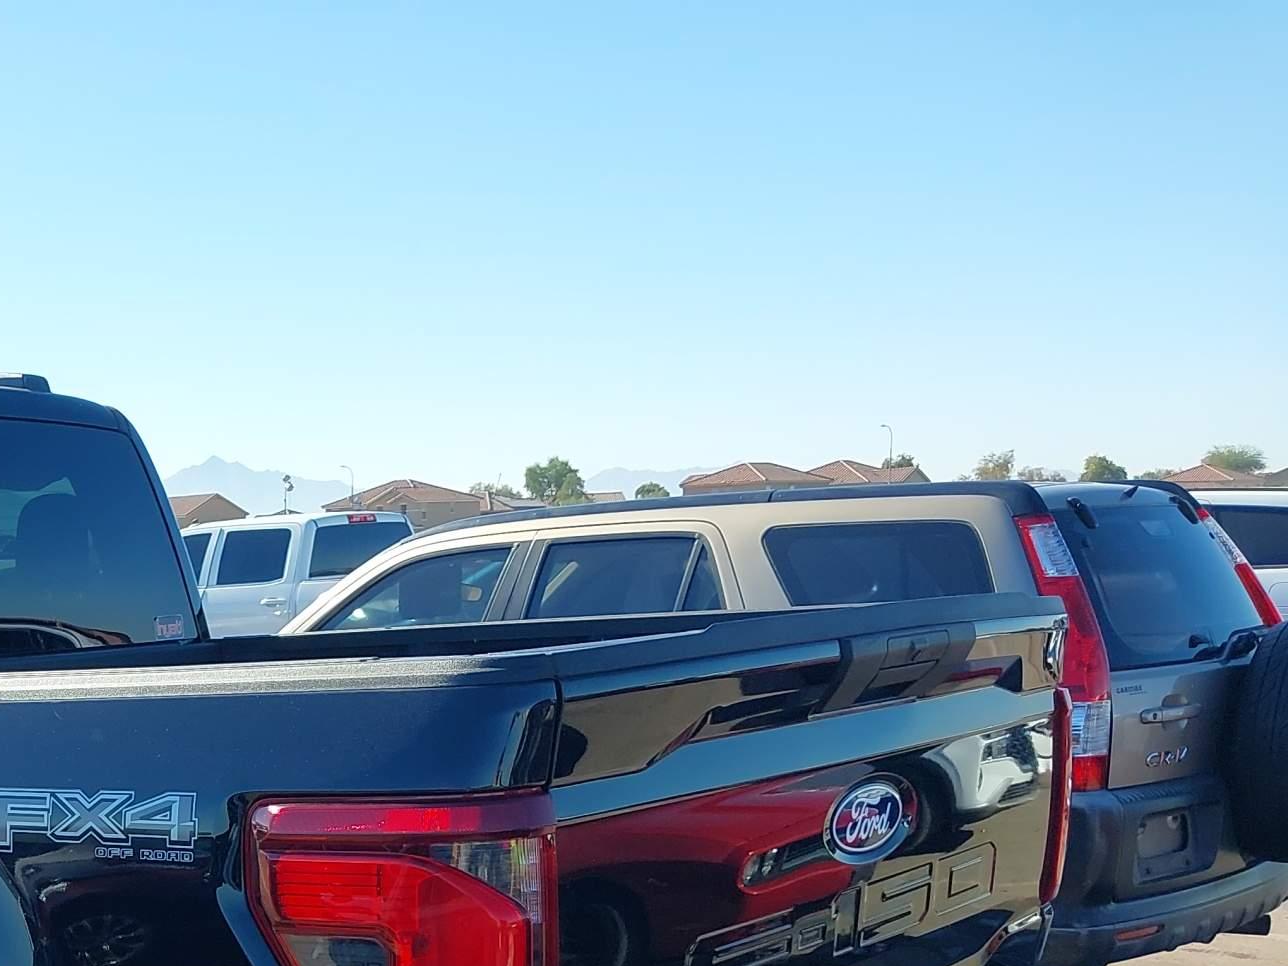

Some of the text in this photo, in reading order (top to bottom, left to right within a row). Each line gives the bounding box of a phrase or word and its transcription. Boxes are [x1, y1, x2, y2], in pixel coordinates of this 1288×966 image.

[1145, 745, 1189, 768] CR-V
[844, 794, 894, 846] Ford
[94, 846, 195, 864] OFF ROAD
